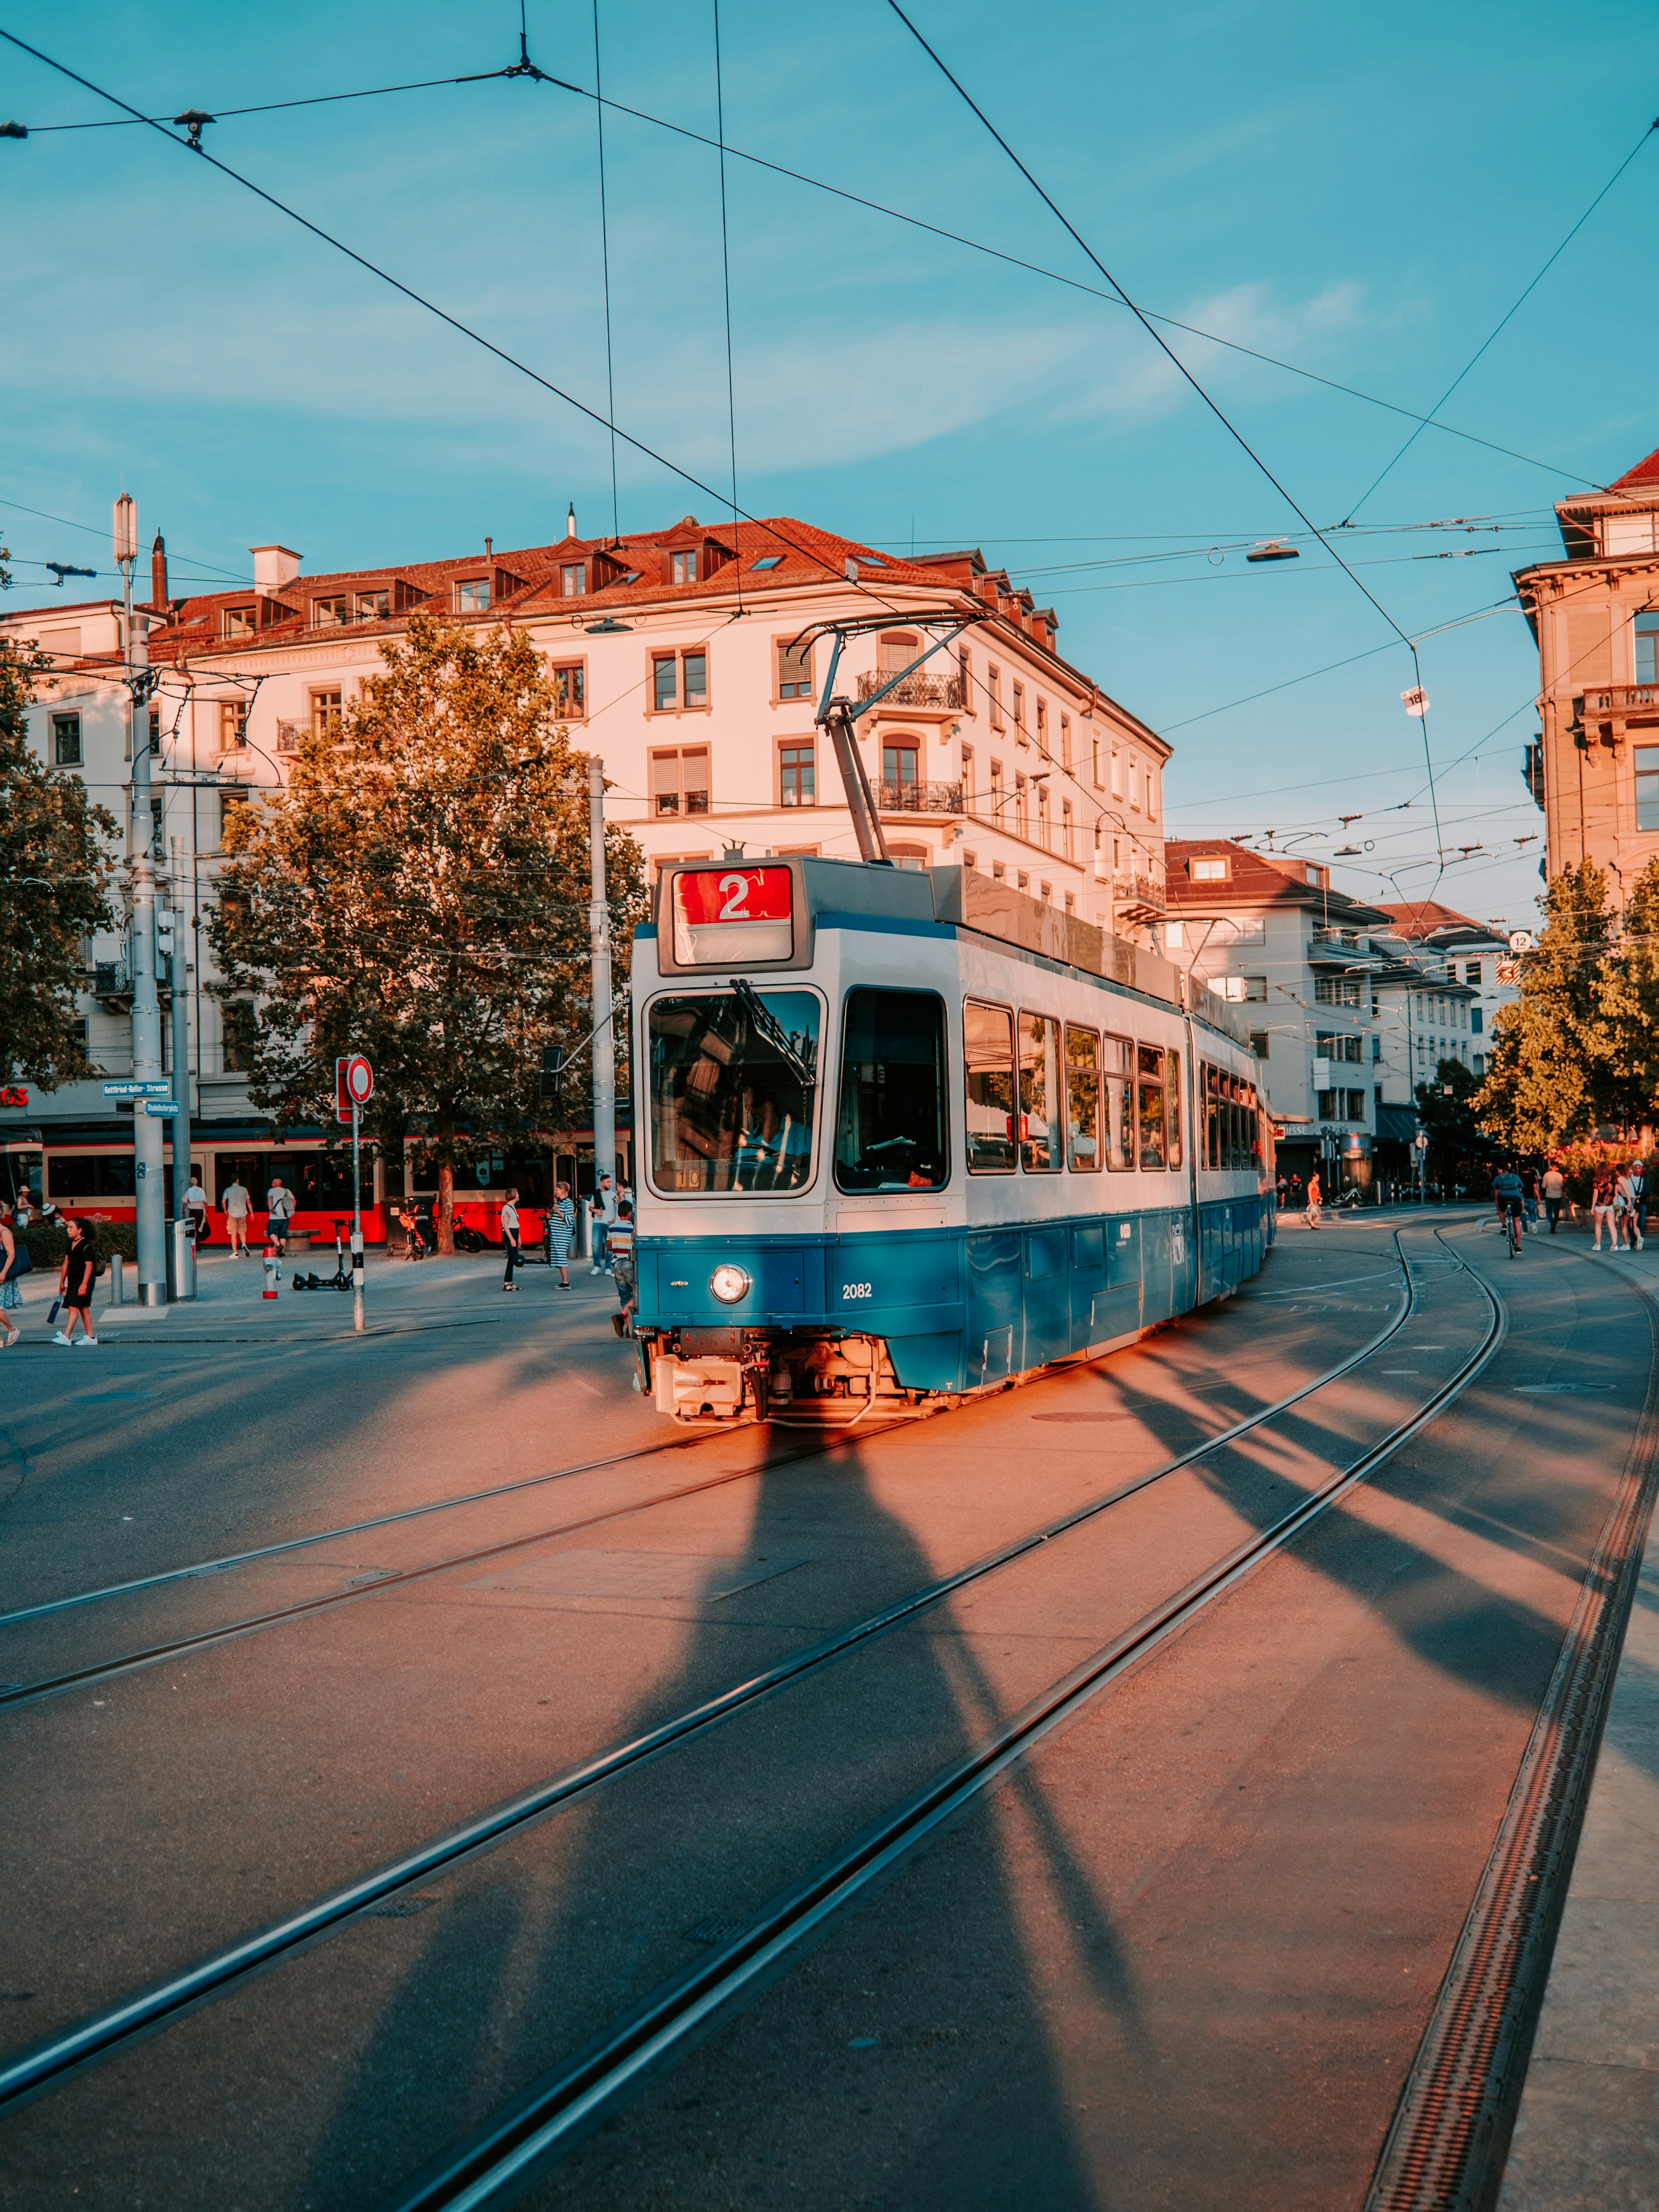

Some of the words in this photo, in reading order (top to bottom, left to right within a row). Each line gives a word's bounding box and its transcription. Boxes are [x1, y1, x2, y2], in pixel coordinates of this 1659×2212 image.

[1409, 694, 1421, 705] 18
[719, 874, 749, 919] 2
[1515, 937, 1526, 946] 12
[843, 1282, 872, 1299] 2082
